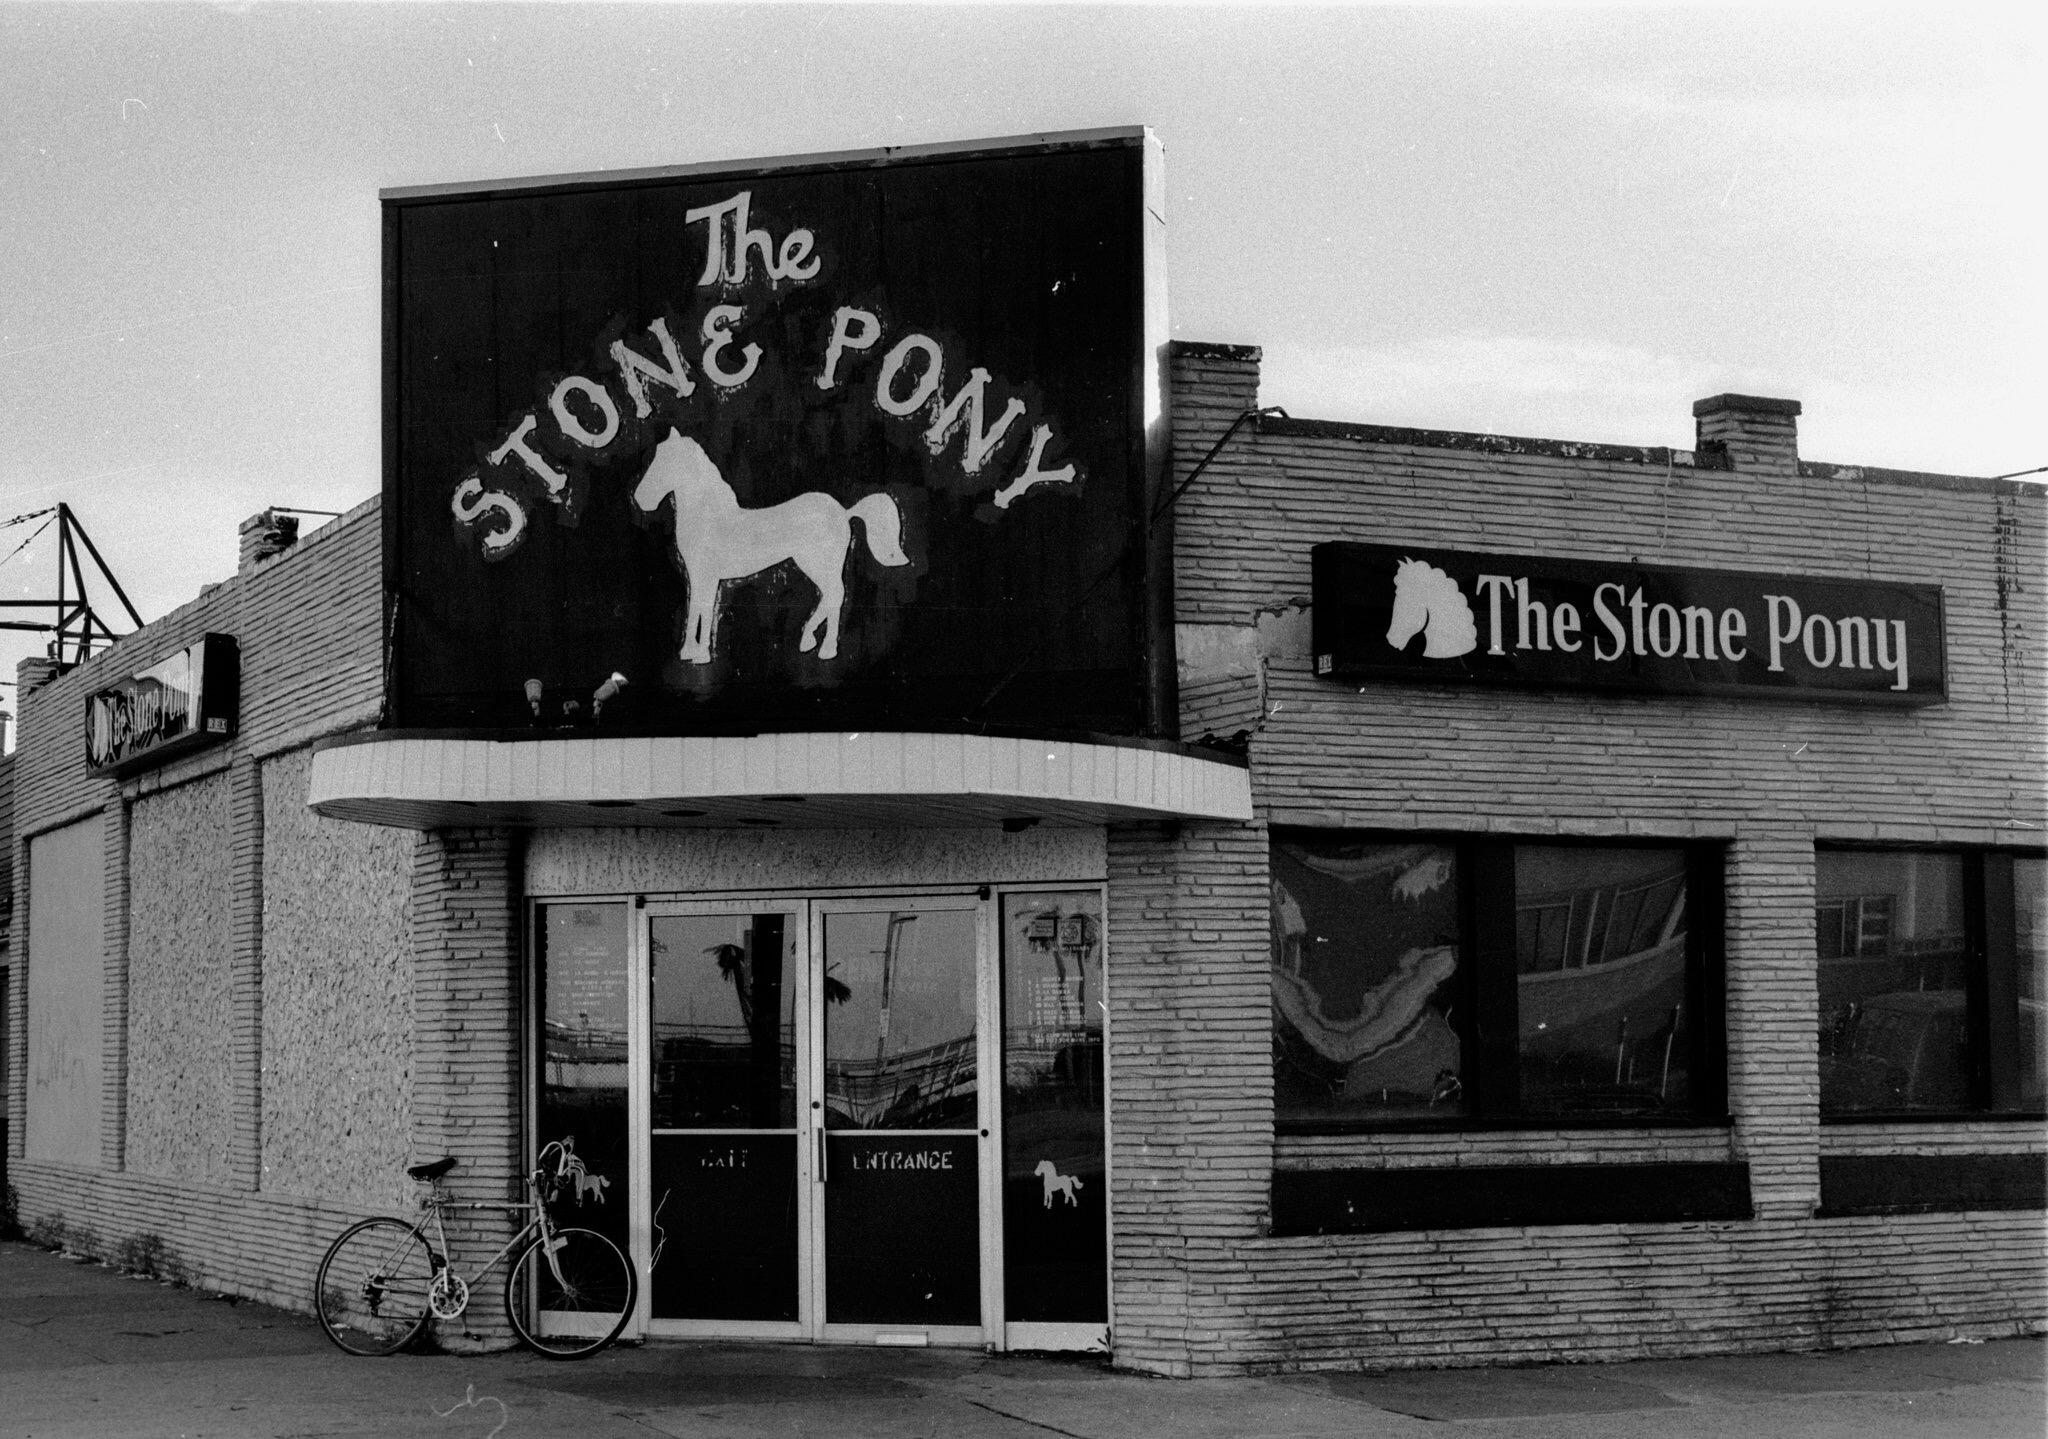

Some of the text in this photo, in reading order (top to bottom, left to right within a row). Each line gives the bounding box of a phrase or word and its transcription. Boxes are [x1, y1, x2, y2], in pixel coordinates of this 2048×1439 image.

[686, 191, 821, 287] The
[452, 304, 1076, 551] STONE PONY
[1476, 573, 1909, 691] The Stone Pony
[101, 695, 127, 753] The
[127, 685, 159, 744] Stone
[852, 1149, 954, 1170] ENTRANCE
